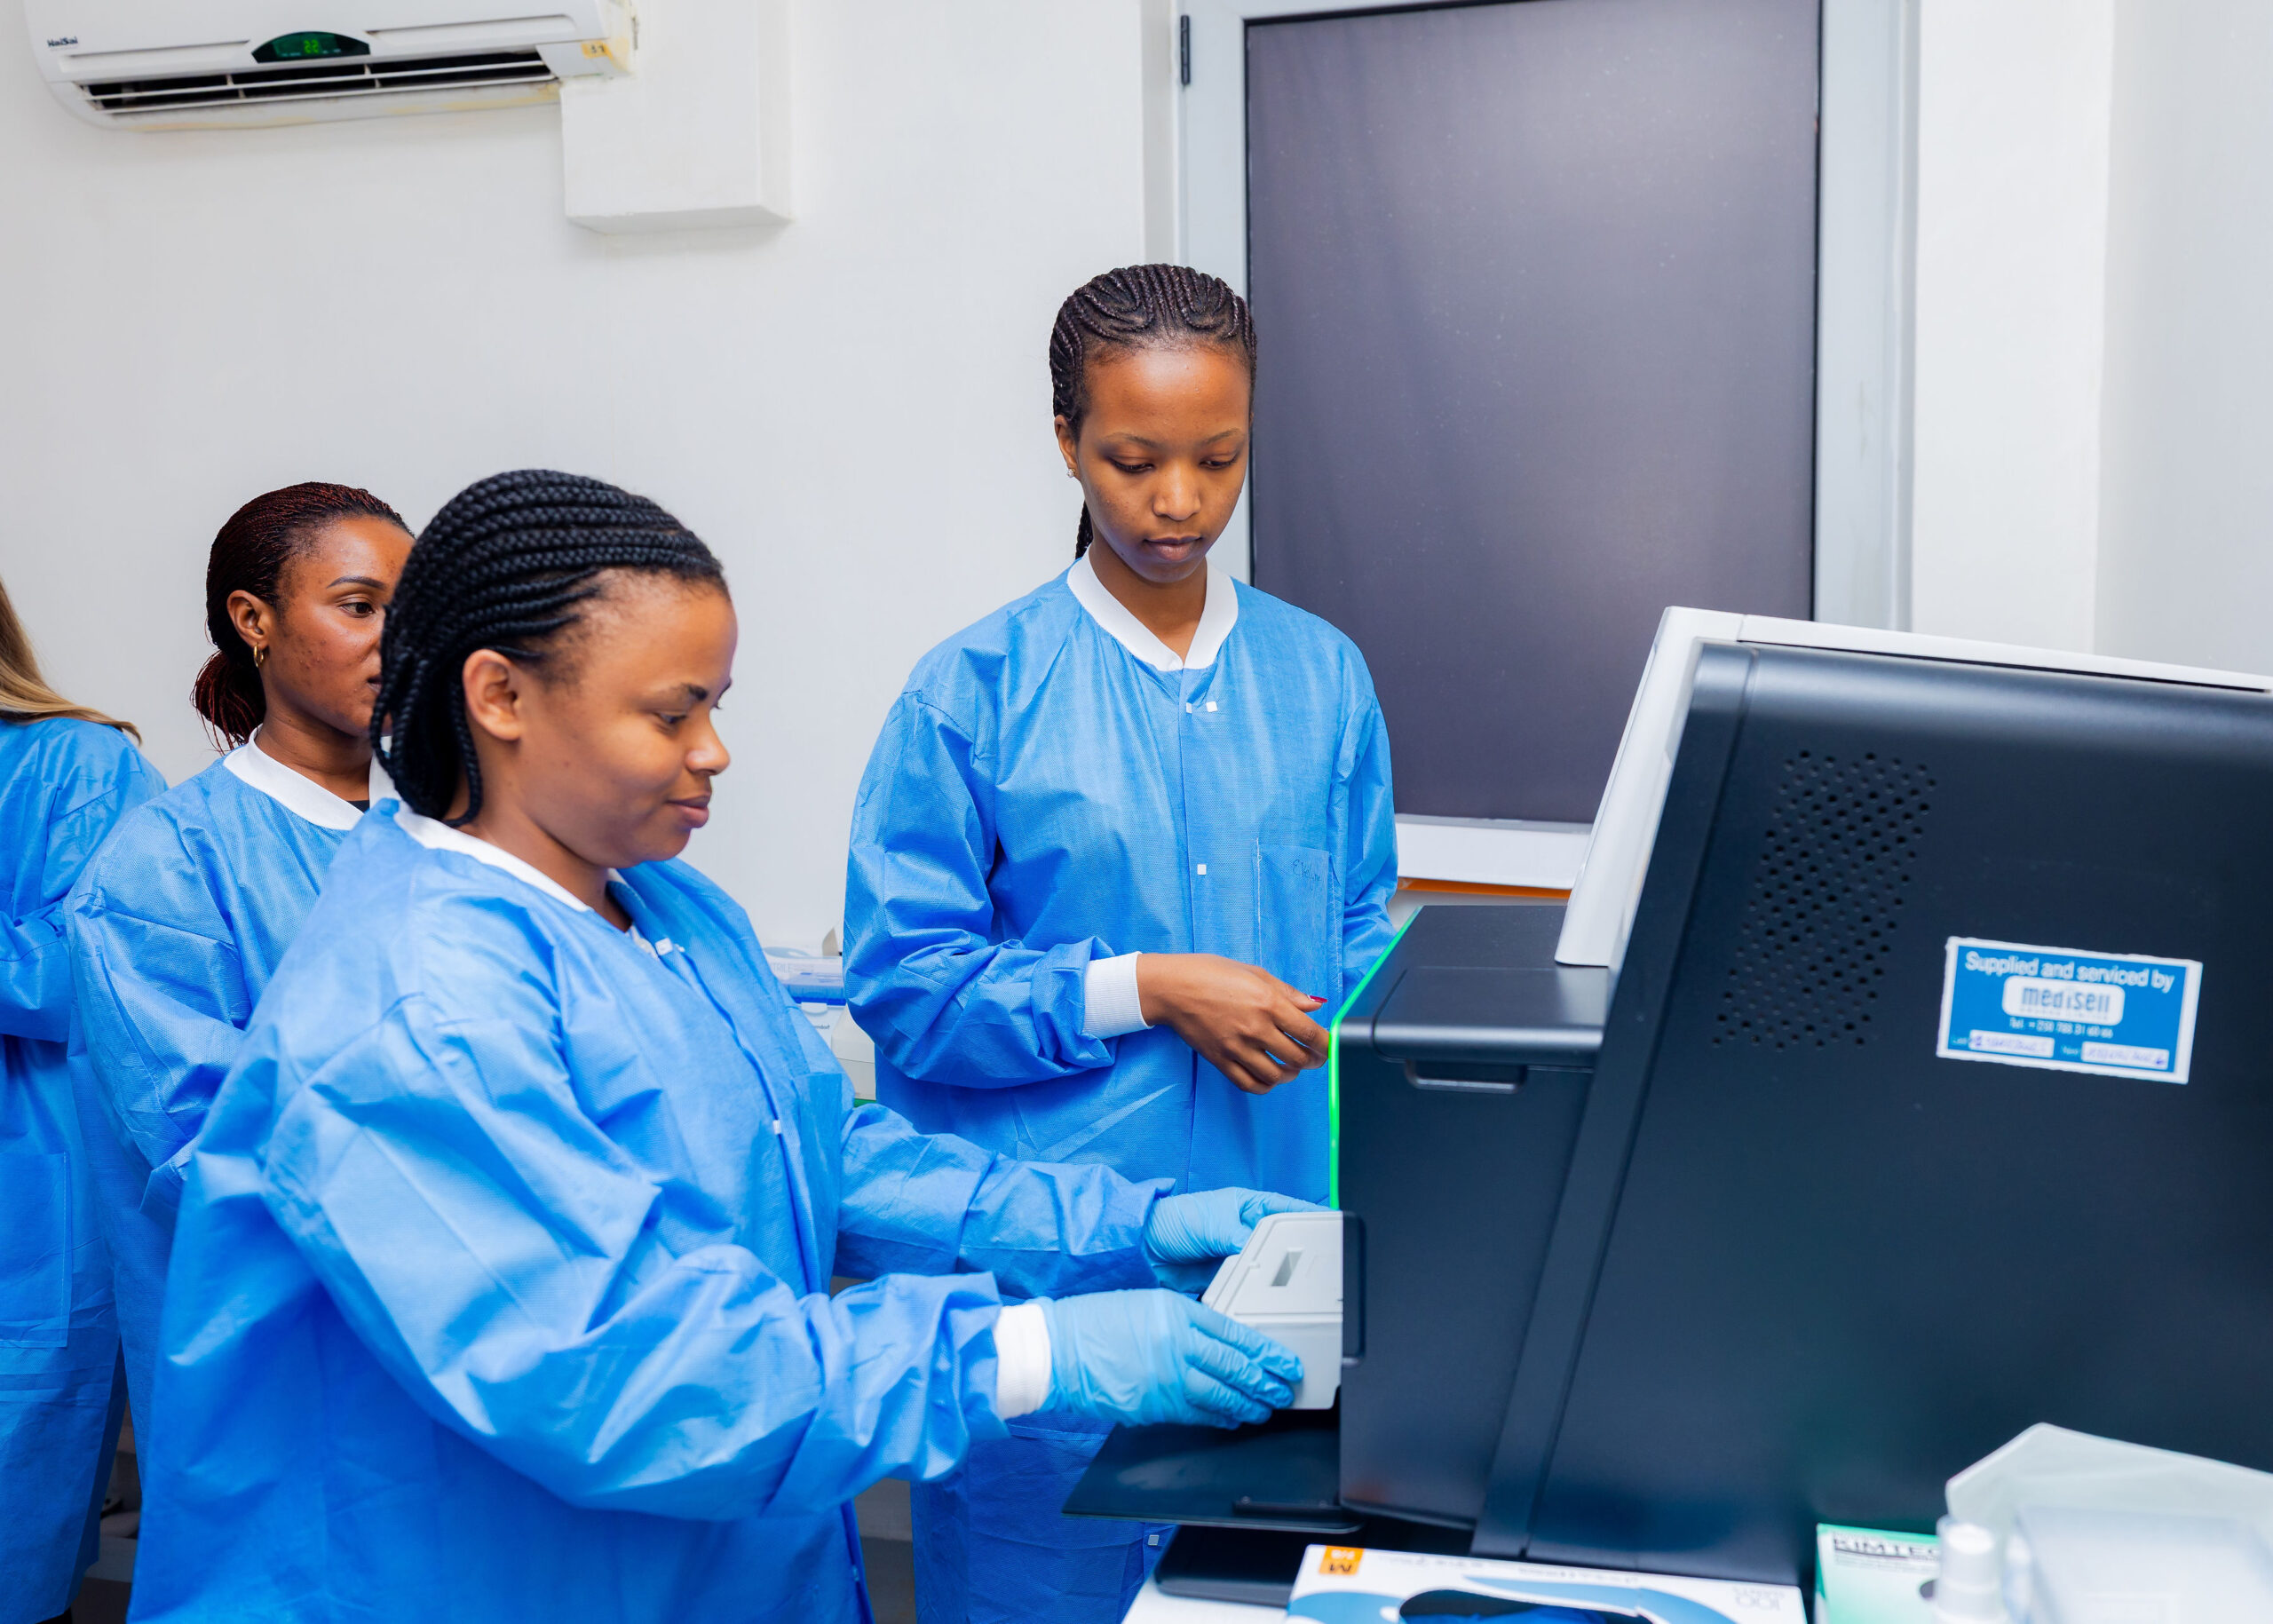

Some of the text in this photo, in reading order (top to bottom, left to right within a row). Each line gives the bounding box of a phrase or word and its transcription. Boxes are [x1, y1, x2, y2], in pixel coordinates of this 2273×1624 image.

[1965, 951, 2175, 994] Supplied and serviced by
